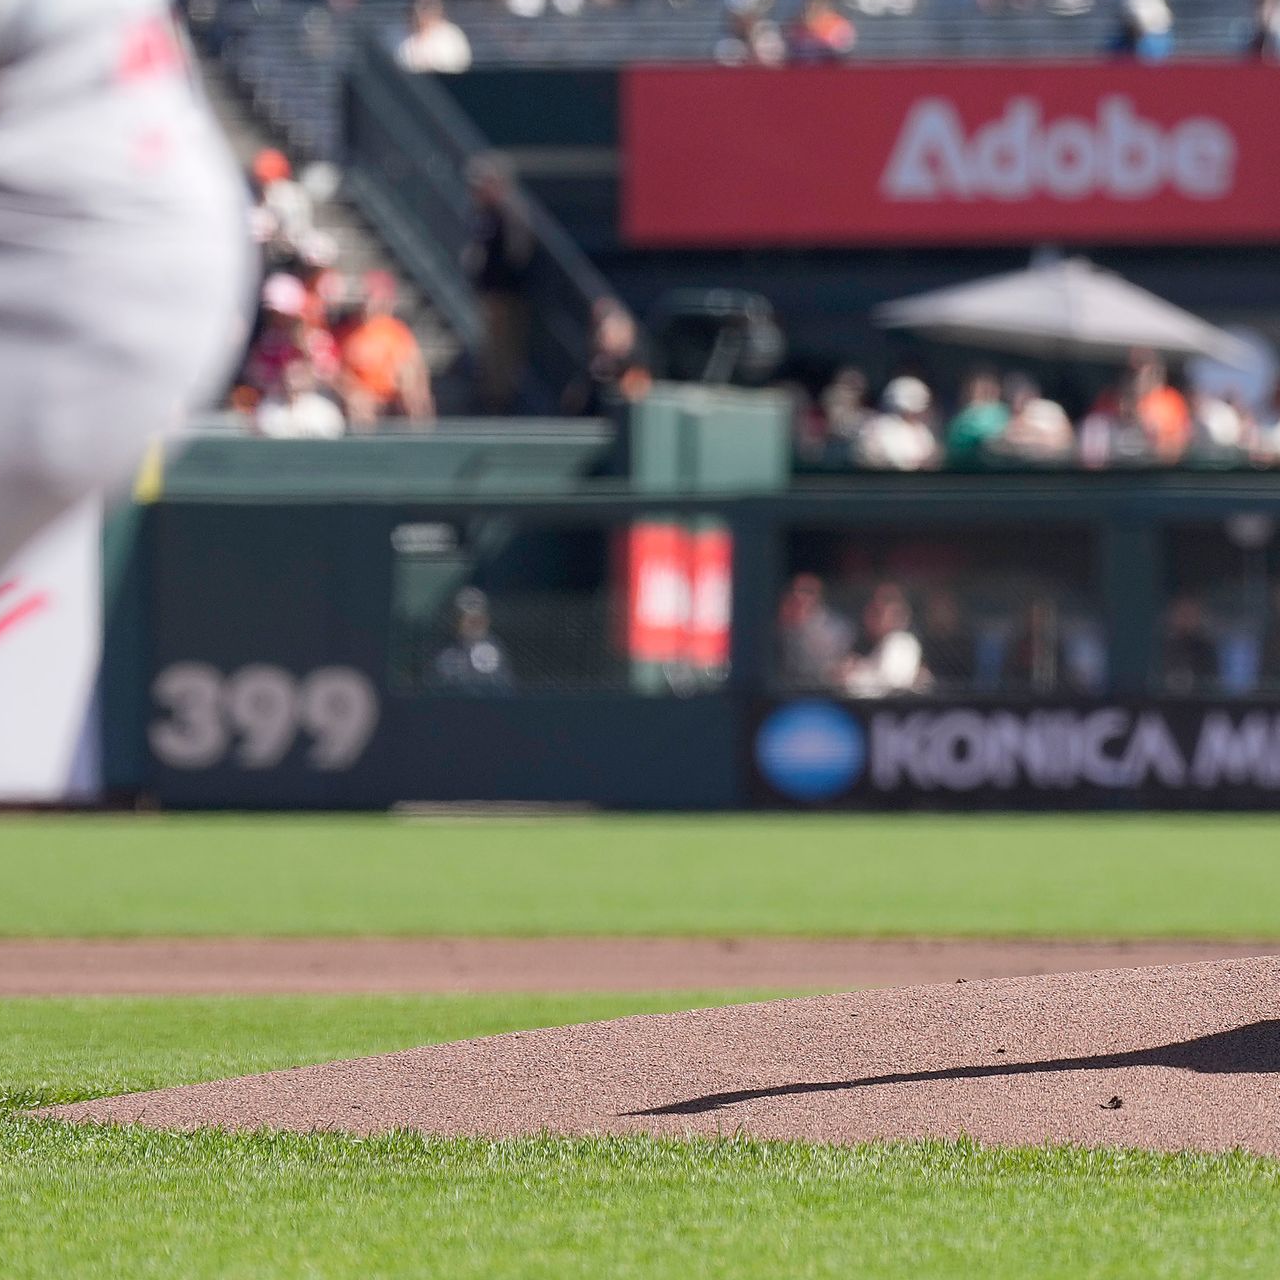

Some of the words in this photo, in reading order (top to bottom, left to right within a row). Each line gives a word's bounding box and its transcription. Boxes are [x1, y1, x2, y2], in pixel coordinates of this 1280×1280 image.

[880, 95, 1238, 202] Adobe
[147, 660, 380, 772] 399
[870, 710, 1188, 791] KONICA
